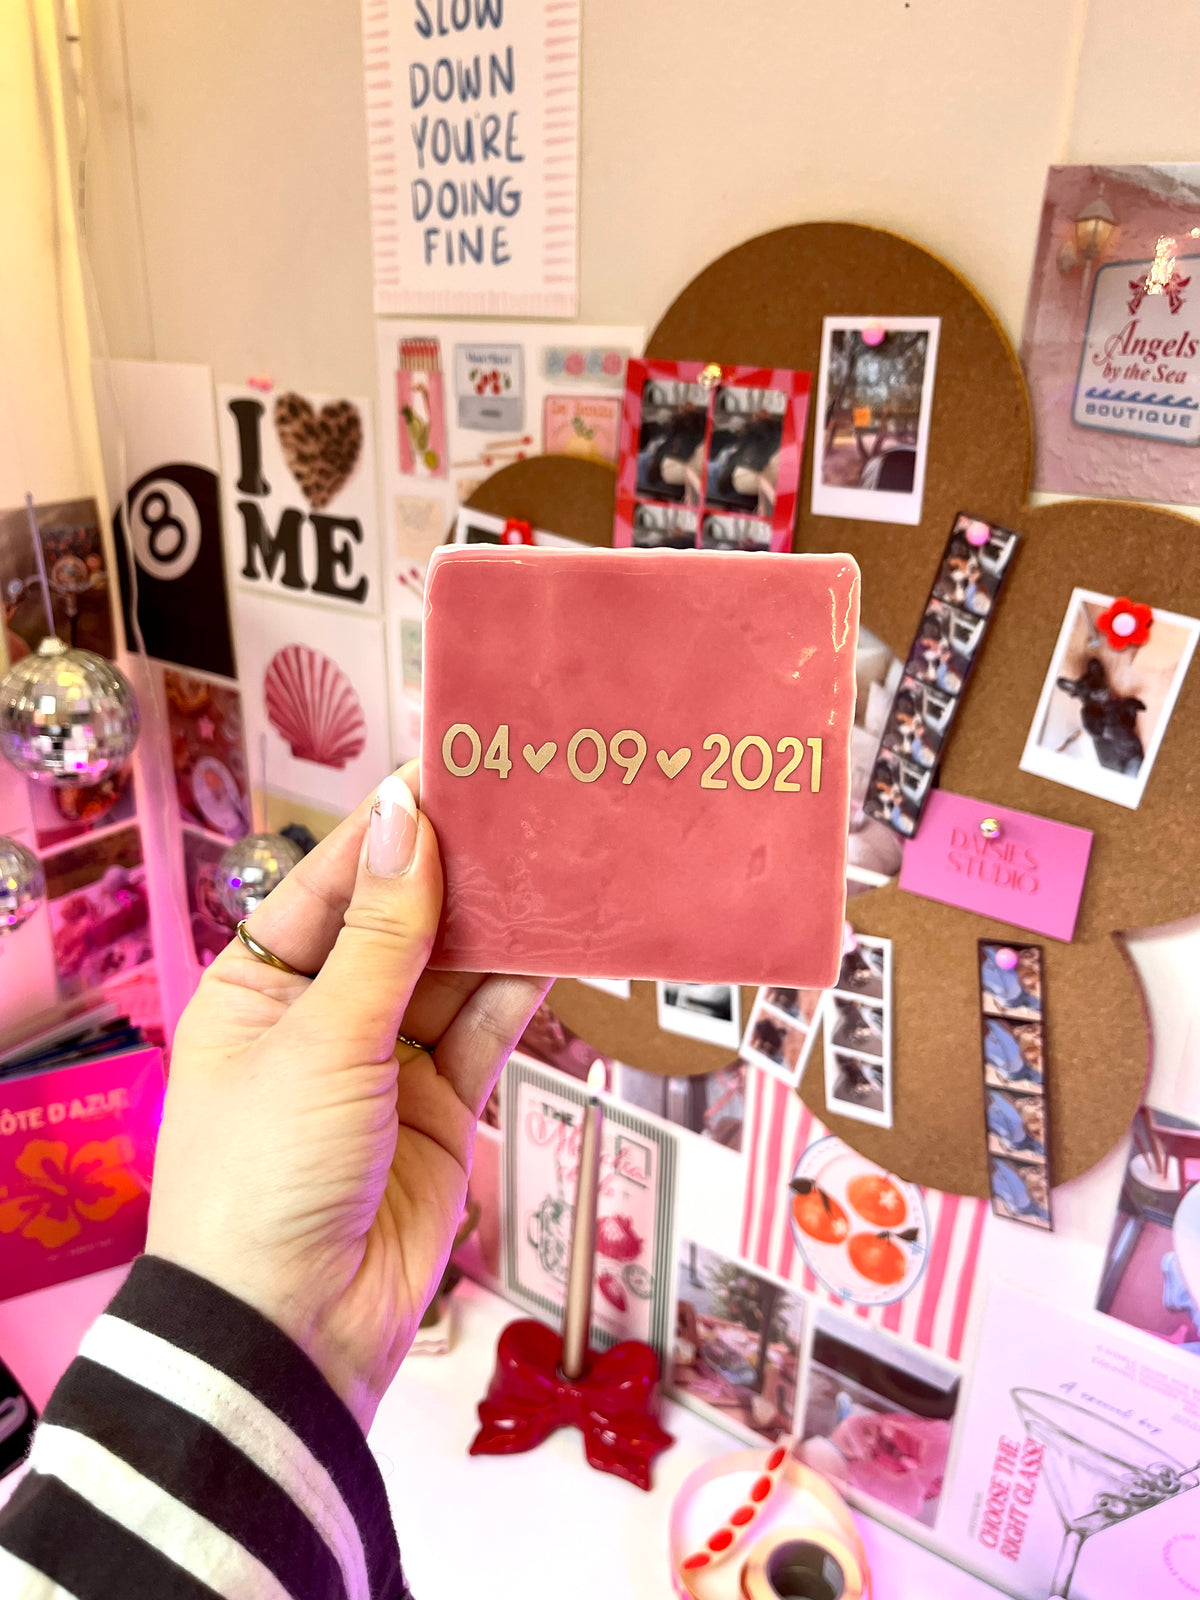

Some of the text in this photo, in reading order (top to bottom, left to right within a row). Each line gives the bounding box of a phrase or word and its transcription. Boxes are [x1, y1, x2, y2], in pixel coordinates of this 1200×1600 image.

[414, 0, 503, 39] SLOW
[409, 45, 515, 109] DOWN
[411, 110, 525, 169] YOU'RE
[411, 175, 521, 222] DOING
[424, 226, 512, 266] FINE
[1092, 319, 1200, 366] Angels
[1102, 361, 1188, 384] by the Sea
[1085, 403, 1192, 428] BOUTIQUE
[228, 398, 271, 496] I
[142, 489, 187, 563] 8
[236, 500, 369, 604] ME
[442, 723, 823, 793] 04 09 2021
[947, 851, 1040, 895] STUDIO
[0, 1107, 46, 1135] ÔTE
[978, 1435, 1020, 1549] CHOOSE THE
[999, 1503, 1029, 1562] RIGHT
